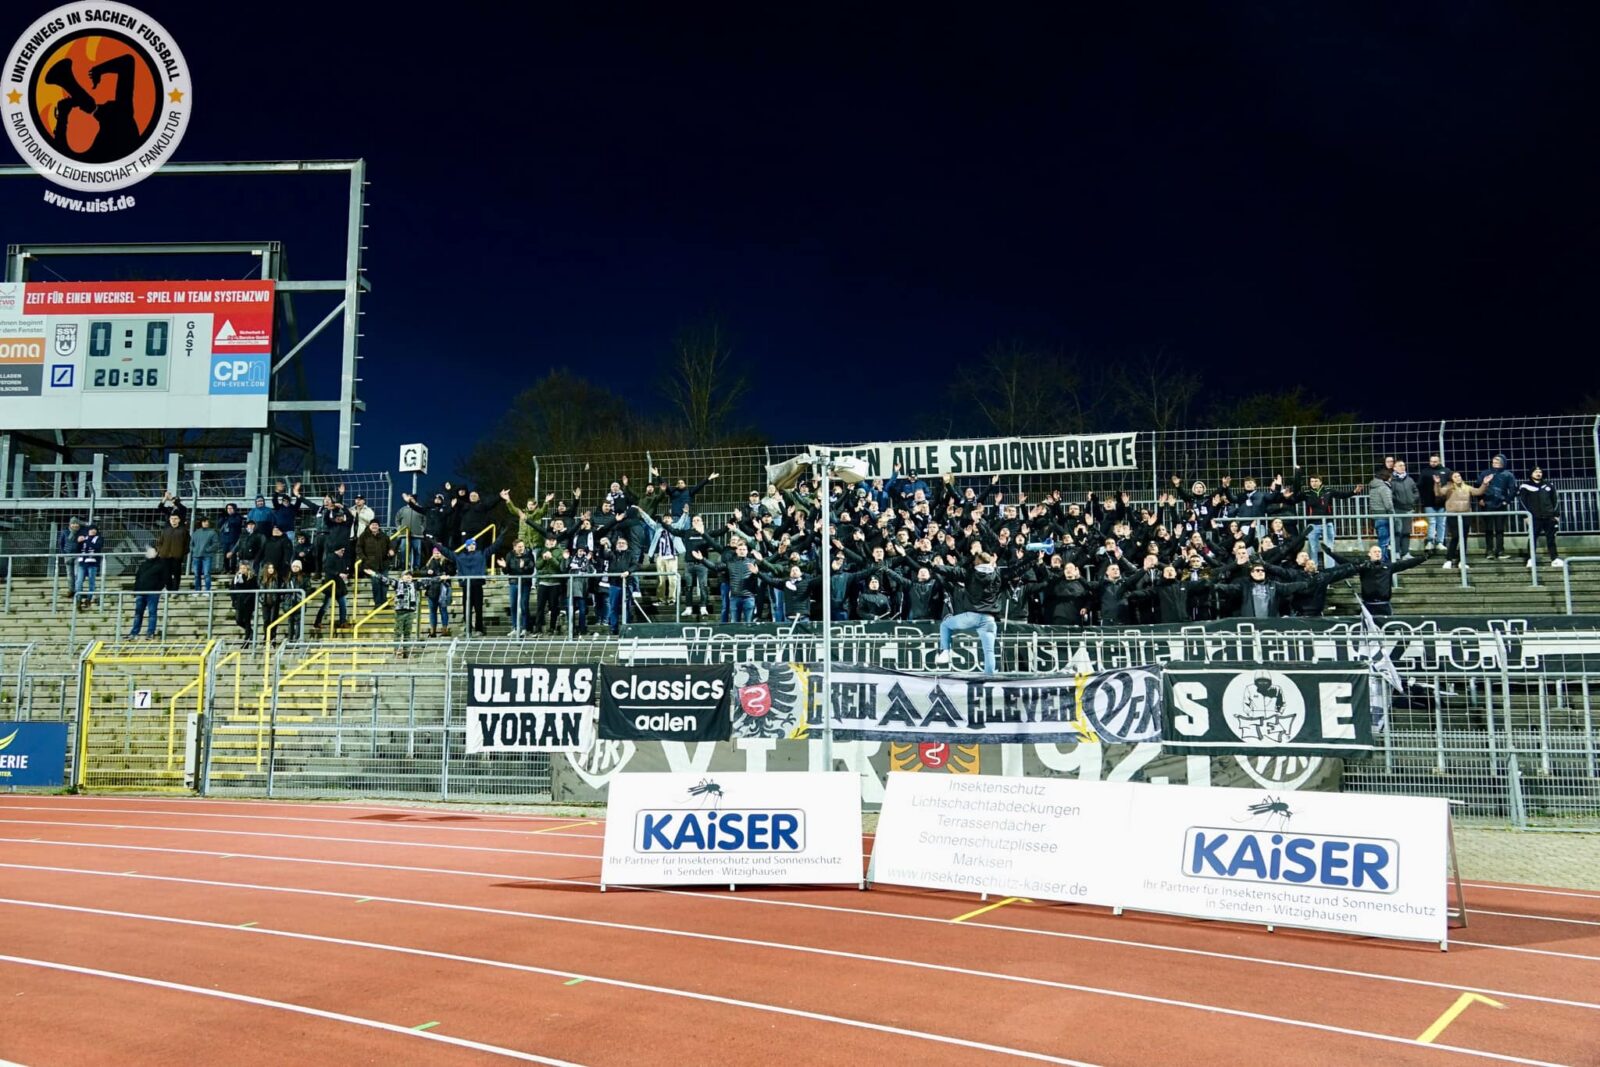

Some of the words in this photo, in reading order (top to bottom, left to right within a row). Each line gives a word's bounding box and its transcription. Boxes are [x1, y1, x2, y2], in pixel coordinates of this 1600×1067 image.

[26, 292, 46, 305] ZEIT
[47, 290, 64, 304] FÜR
[66, 291, 92, 304] EINEN
[93, 291, 136, 304] WECHSEL
[146, 290, 172, 303] SPIEL
[173, 291, 187, 303] IM
[188, 290, 212, 303] TEAM
[214, 290, 270, 303] SYSTEMZWO
[184, 321, 195, 357] GAST
[94, 368, 158, 387] 20:36
[404, 448, 417, 468] G
[893, 445, 939, 475] ALLE
[950, 436, 1134, 474] STADIONVERBOTE
[473, 667, 593, 703] ULTRAS
[610, 674, 725, 701] classics
[139, 691, 149, 707] 7
[1173, 681, 1210, 736] S
[1319, 682, 1356, 740] E
[478, 712, 583, 747] VORAN
[634, 714, 698, 733] aalen
[949, 780, 1047, 796] Insektenschutz
[911, 796, 1081, 818] Lichtschachtabdeckungen
[919, 831, 1058, 854] Sonnenschutzplissee
[609, 856, 622, 865] Ihr
[625, 856, 660, 865] Partner
[678, 856, 750, 865] Insektenschutz
[752, 856, 771, 865] und
[774, 855, 842, 865] Sonnenschutz
[952, 853, 1014, 870] Markisen
[663, 867, 673, 876] in
[677, 867, 714, 876] Senden
[722, 867, 787, 878] Witzighausen
[1143, 879, 1158, 890] Ihr
[1160, 881, 1201, 895] Partner
[1222, 886, 1311, 904] Insektenschutz
[1314, 895, 1339, 907] und
[1342, 896, 1437, 917] Sonnenschutz
[1205, 898, 1217, 910] in
[1219, 898, 1263, 913] Senden
[1273, 903, 1358, 923] Witzighausen
